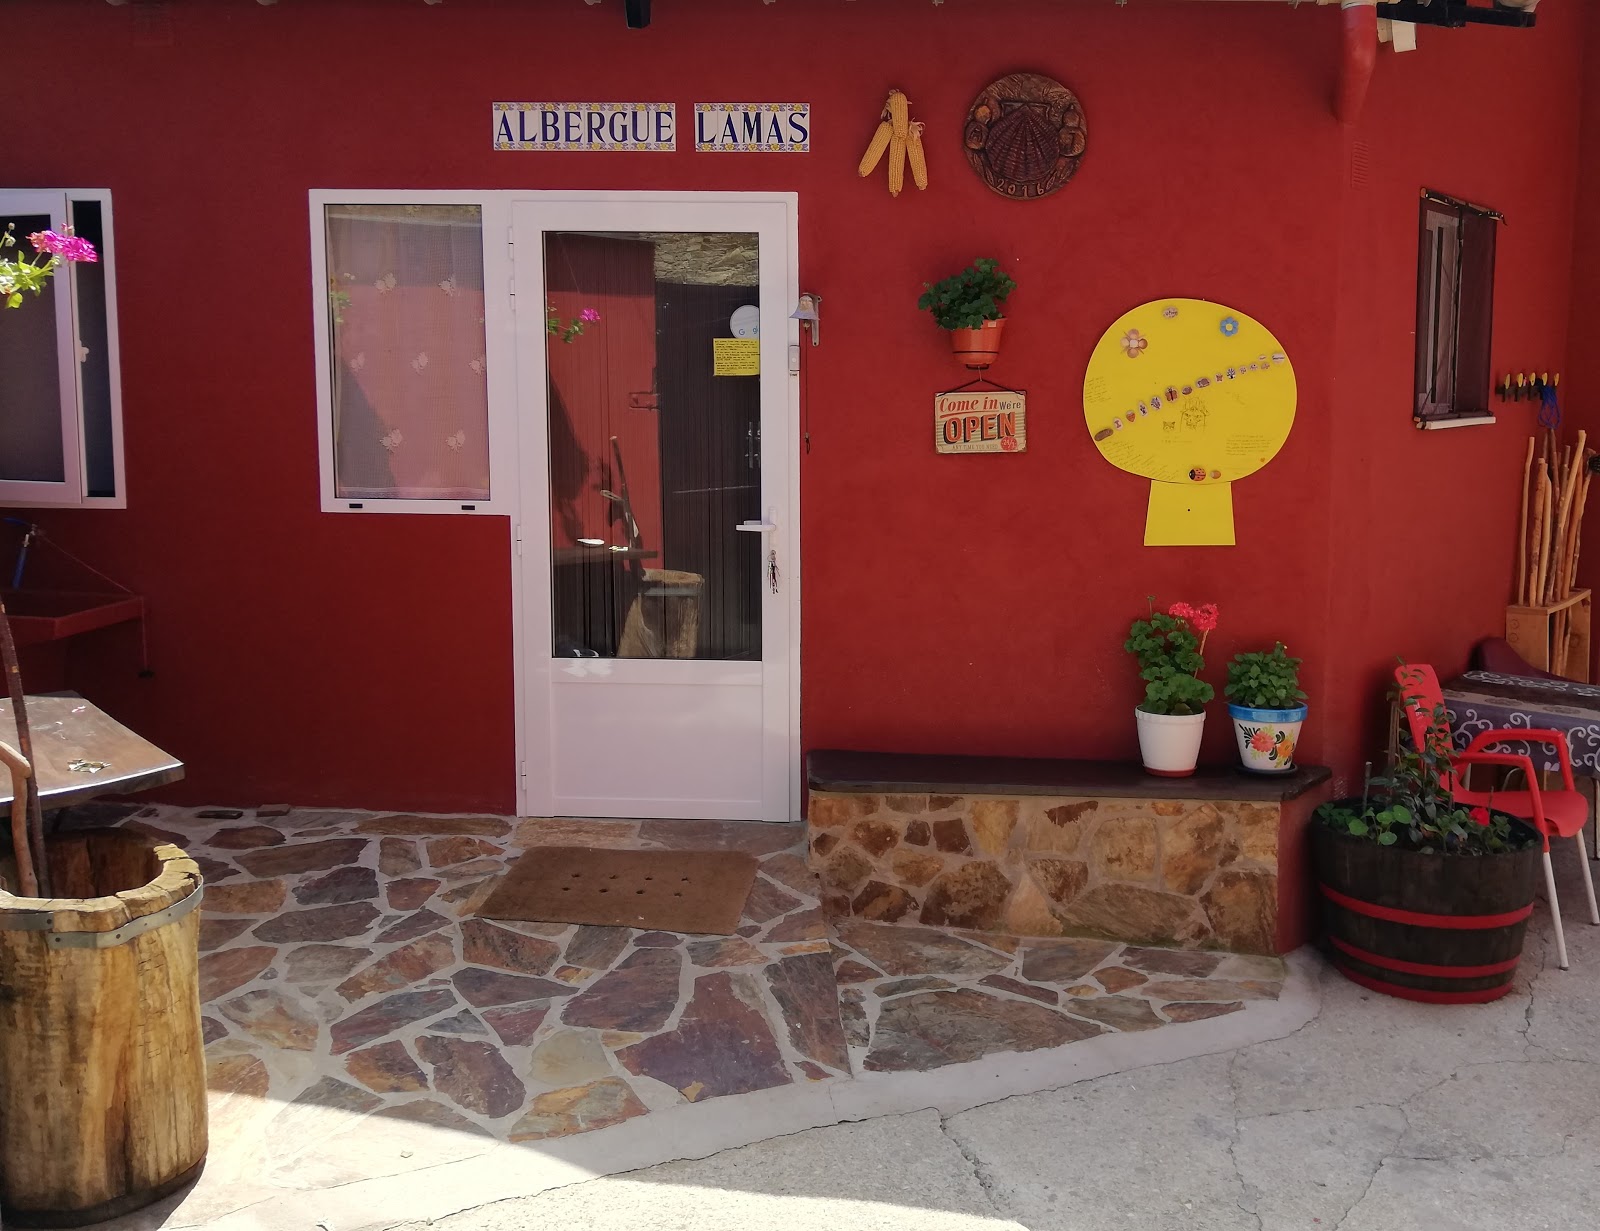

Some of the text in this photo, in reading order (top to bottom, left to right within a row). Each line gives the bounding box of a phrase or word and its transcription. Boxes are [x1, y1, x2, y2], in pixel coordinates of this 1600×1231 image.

[496, 111, 809, 144] ALBERGUE LAMAS
[996, 178, 1044, 197] 2016
[940, 396, 1021, 412] Come in We're
[943, 411, 1016, 444] OPEN
